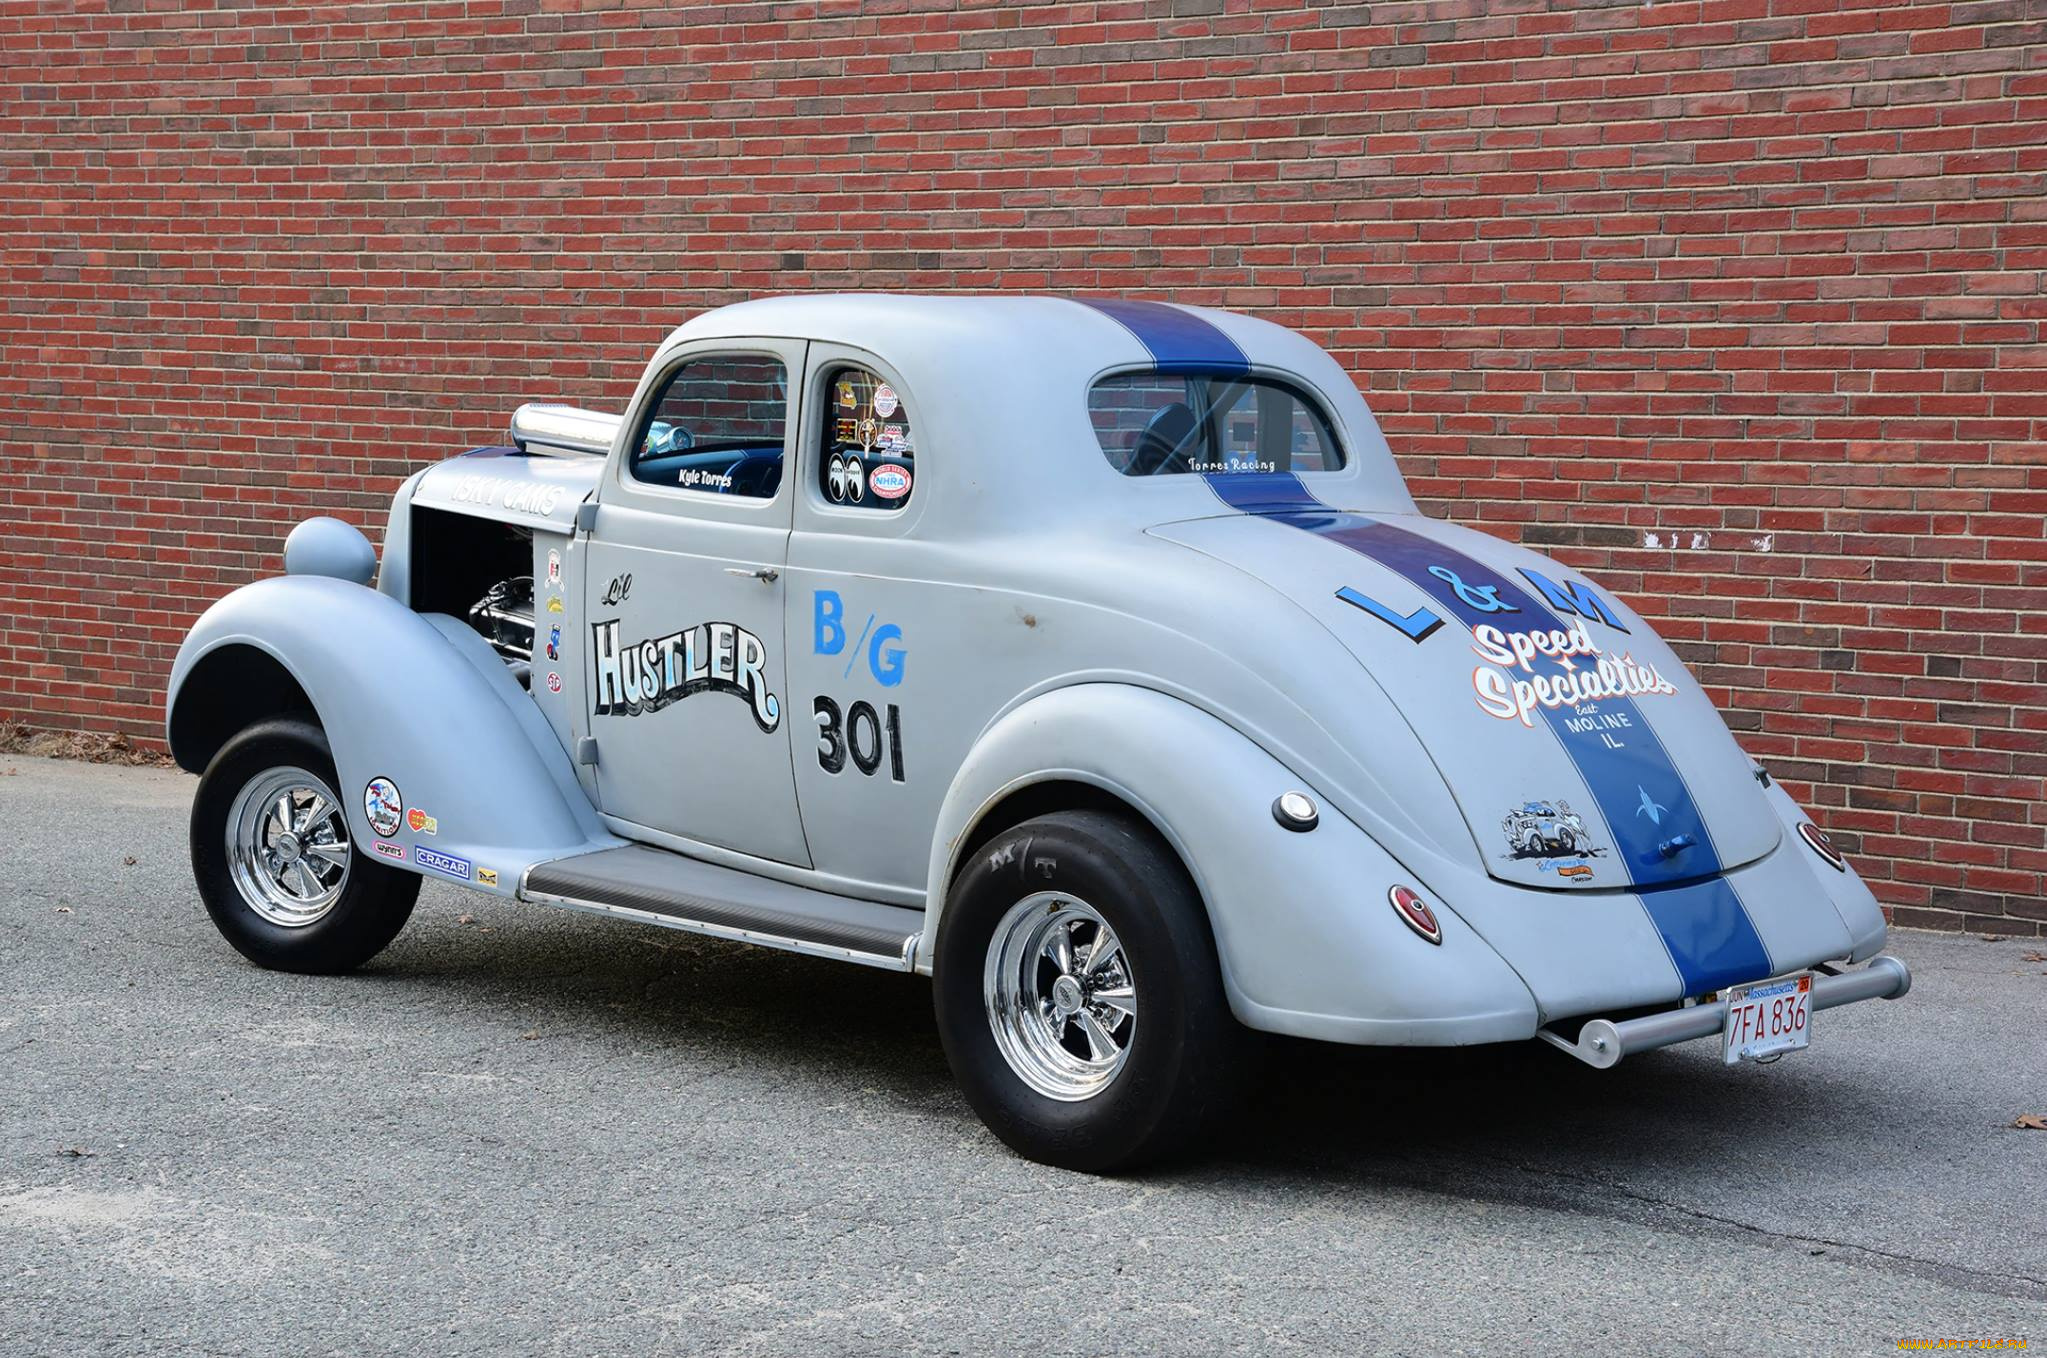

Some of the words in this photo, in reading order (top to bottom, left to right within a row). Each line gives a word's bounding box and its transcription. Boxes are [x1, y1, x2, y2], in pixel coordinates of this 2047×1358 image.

[679, 469, 699, 486] Kyle
[701, 470, 732, 487] Torres
[1188, 458, 1228, 471] Torres
[1230, 458, 1275, 473] Racing
[876, 476, 904, 486] NHRA
[502, 481, 567, 517] CAMS
[1335, 586, 1446, 645] L
[1427, 566, 1521, 613] &
[1515, 567, 1632, 635] M
[813, 589, 907, 687] B/G
[1471, 618, 1602, 673] Speed
[547, 674, 561, 692] STP
[591, 618, 781, 734] HUSTLER
[1471, 651, 1680, 728] Specialties
[1565, 713, 1632, 733] MOLINE
[1575, 703, 1599, 716] East
[812, 695, 907, 784] 301
[418, 852, 466, 874] CRAGAR
[1731, 991, 1745, 1003] JUN
[1747, 981, 1794, 1001] Massachusetts
[1730, 1003, 1765, 1047] 7FA
[1772, 994, 1807, 1036] 836
